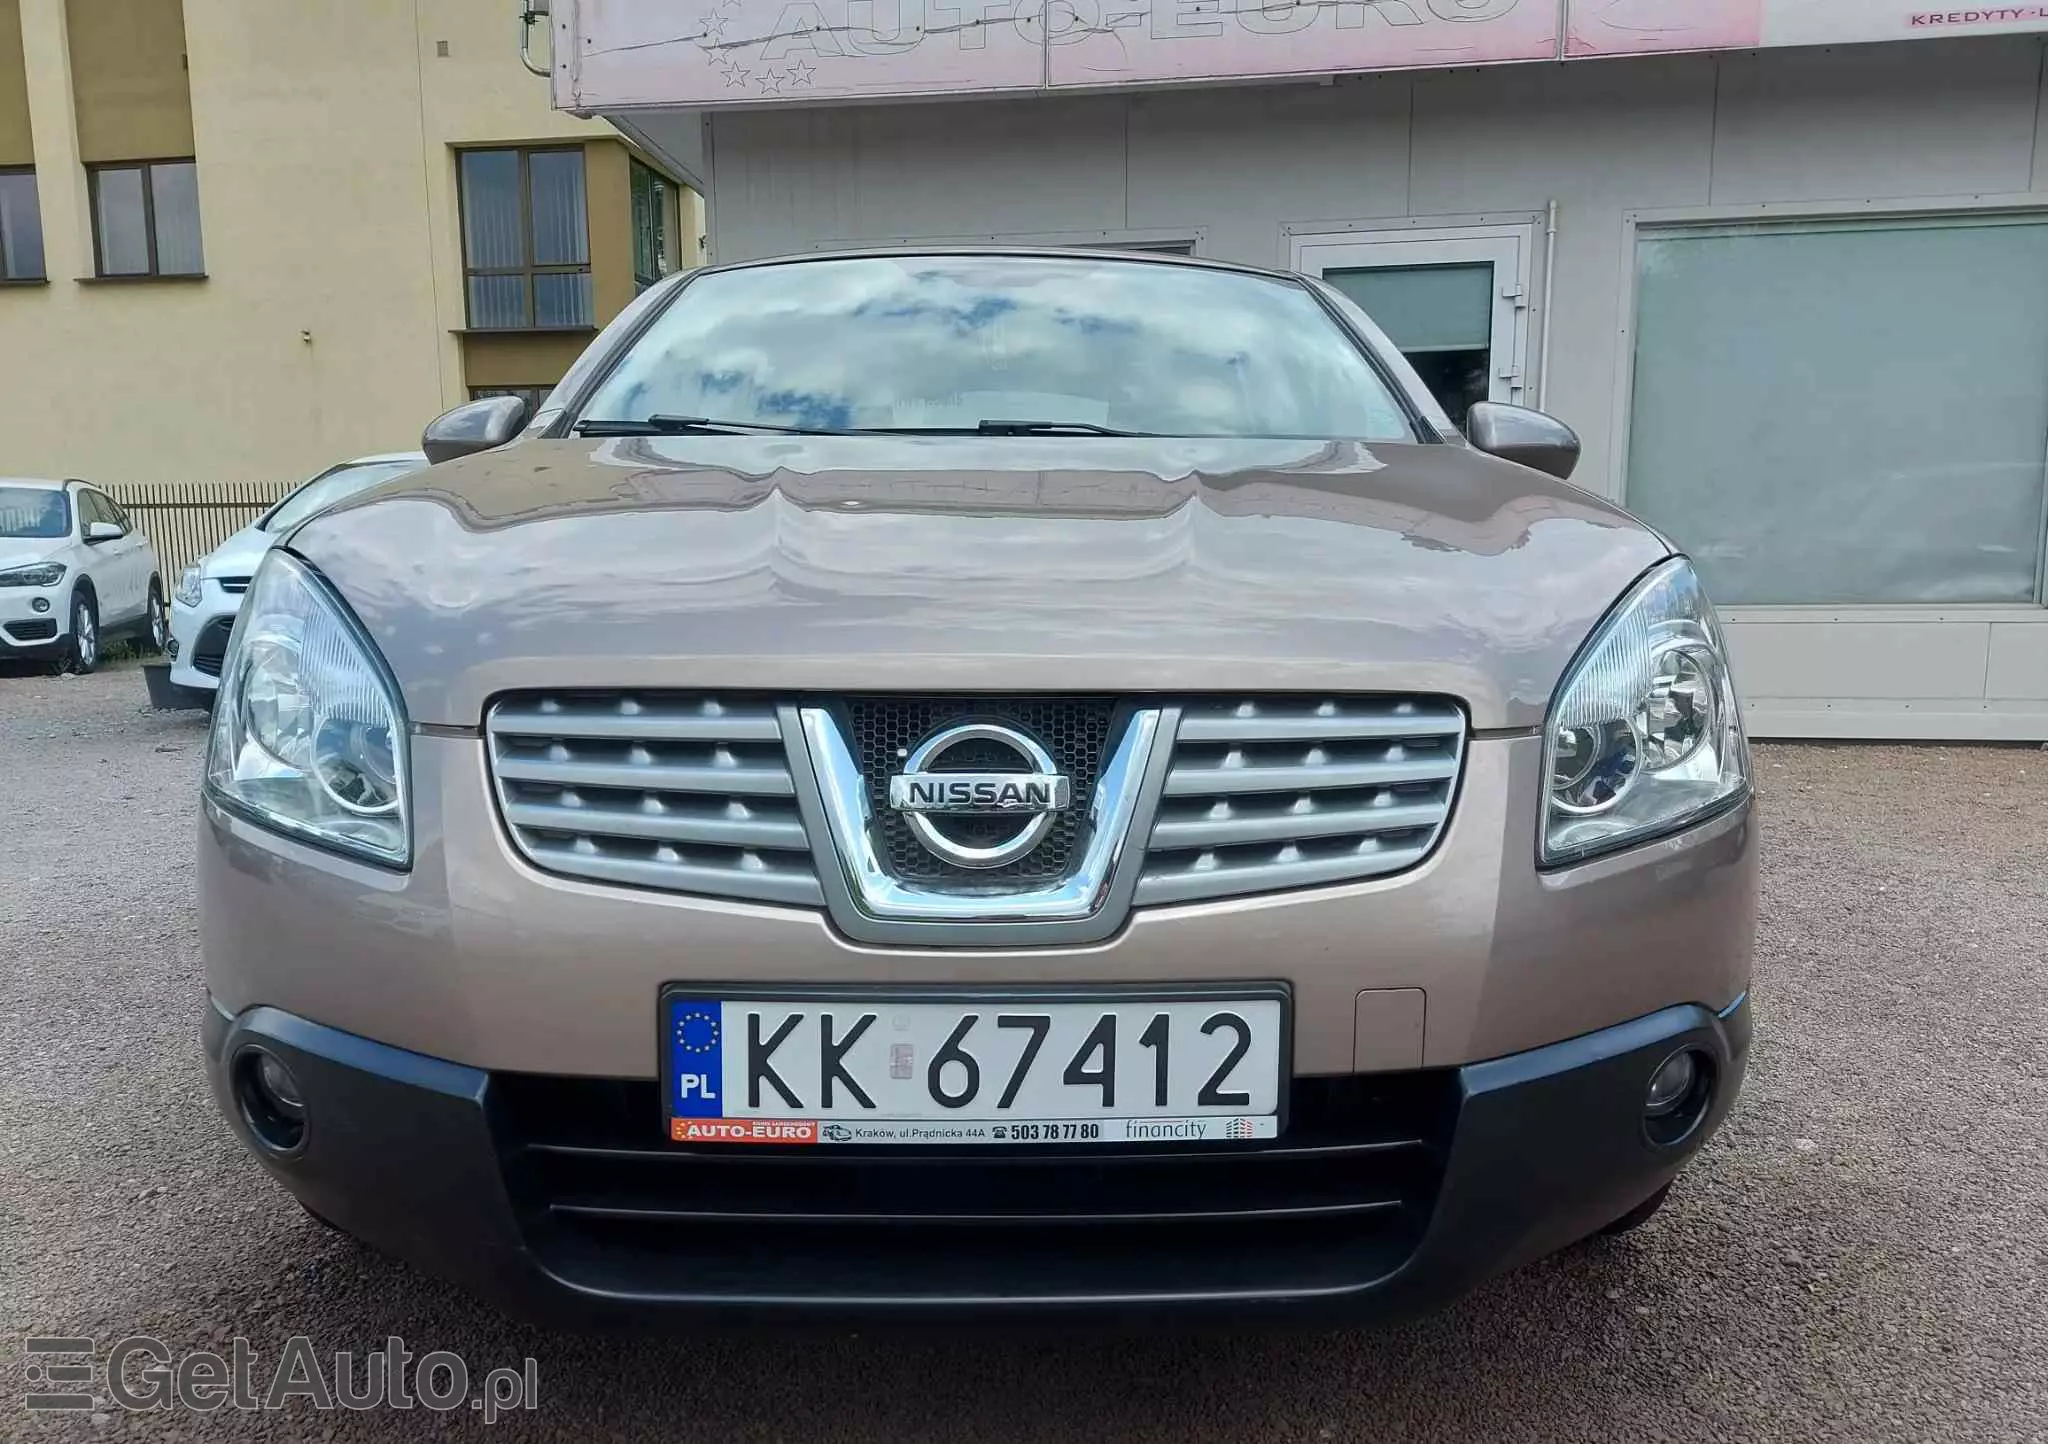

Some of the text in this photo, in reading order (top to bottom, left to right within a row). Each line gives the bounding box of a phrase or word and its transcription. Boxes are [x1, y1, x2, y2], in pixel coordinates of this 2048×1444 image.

[1911, 8, 2025, 26] KREDYTY
[909, 782, 1051, 803] NISSAN
[748, 1013, 1252, 1109] KK 67412
[681, 1074, 716, 1099] PL
[687, 1125, 812, 1138] AUTO-EURO
[966, 1128, 985, 1137] 44A
[1011, 1123, 1099, 1140] 503 78 77 80
[1126, 1119, 1207, 1139] financity
